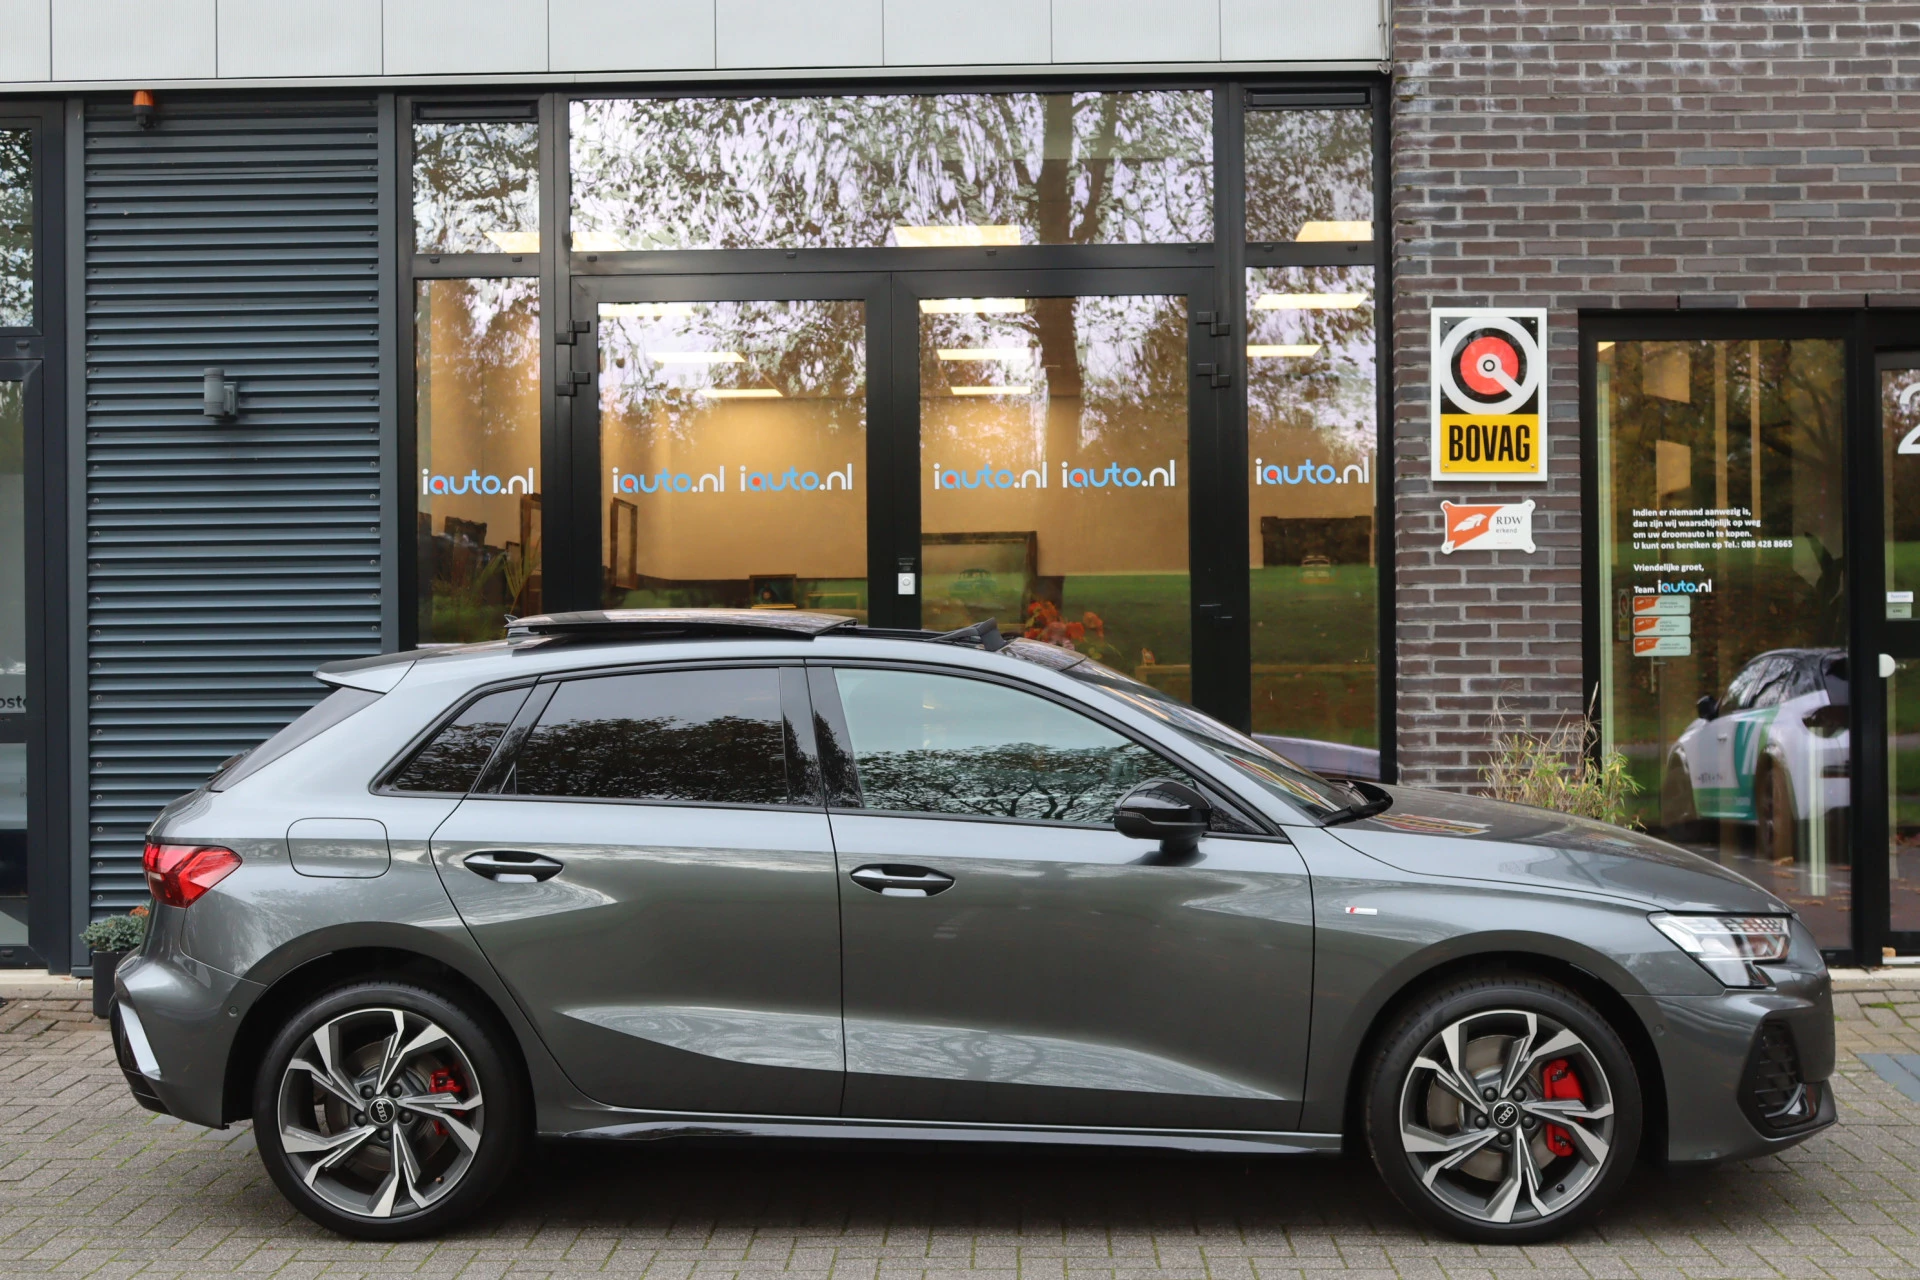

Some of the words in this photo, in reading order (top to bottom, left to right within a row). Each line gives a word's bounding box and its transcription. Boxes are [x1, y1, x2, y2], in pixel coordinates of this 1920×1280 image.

[1449, 424, 1531, 462] BOVAG
[740, 463, 853, 492] iauto.nl
[933, 461, 1048, 490] iauto.nl
[1061, 459, 1176, 488] iauto.nl
[1255, 457, 1370, 485] iauto.nl
[422, 467, 534, 495] iauto.nl
[612, 465, 724, 494] iauto.nl
[1496, 515, 1523, 525] RDW
[1632, 508, 1658, 517] Indien
[1668, 507, 1704, 516] niemand
[1704, 507, 1741, 517] aanwezig
[1742, 507, 1751, 516] is,
[1632, 519, 1648, 528] dan
[1649, 519, 1664, 529] zijn
[1664, 519, 1677, 528] wij
[1678, 518, 1732, 528] waarschijnlijk
[1732, 519, 1743, 528] op
[1744, 519, 1761, 527] weg
[1633, 531, 1646, 539] om
[1648, 531, 1660, 539] uw
[1661, 530, 1705, 539] droomauto
[1706, 529, 1714, 538] in
[1716, 530, 1725, 538] te
[1725, 529, 1752, 539] kopen.
[1633, 541, 1640, 550] U
[1641, 541, 1659, 549] kunt
[1676, 540, 1711, 549] bereiken
[1711, 541, 1723, 550] op
[1723, 540, 1740, 549] Tel.:
[1741, 540, 1756, 548] 088
[1757, 540, 1772, 548] 428
[1773, 540, 1793, 548] 8665
[1633, 563, 1680, 572] Vriendelijke
[1681, 563, 1705, 573] groet,
[1633, 586, 1656, 594] Team
[1657, 578, 1712, 593] iauto.nl
[0, 695, 26, 709] ost
